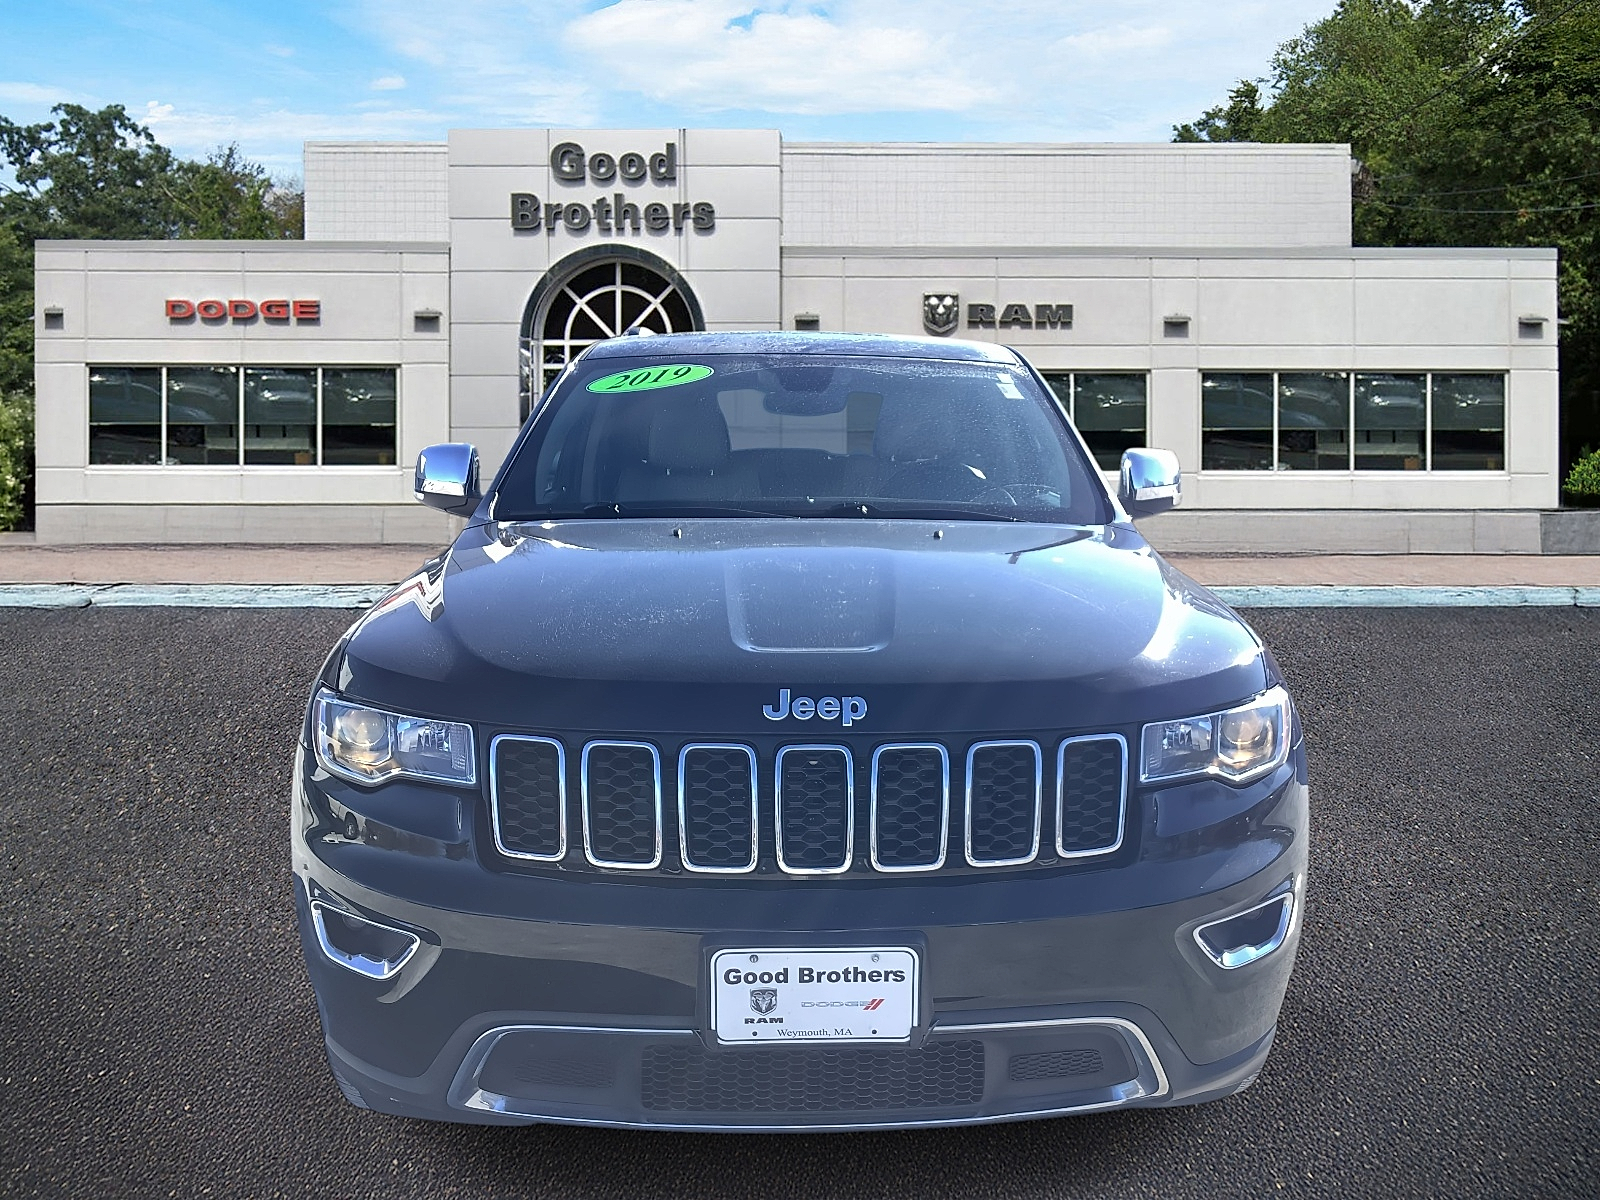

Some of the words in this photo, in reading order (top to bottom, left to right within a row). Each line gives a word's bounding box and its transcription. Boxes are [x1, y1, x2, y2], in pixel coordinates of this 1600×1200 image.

[550, 142, 677, 181] Good
[510, 192, 716, 230] Brothers
[165, 299, 321, 319] DODGE
[967, 303, 1074, 323] RAM
[606, 366, 692, 390] 2019
[762, 688, 868, 727] Jeep
[723, 967, 789, 985] Good
[798, 966, 906, 984] Brothers
[800, 1000, 872, 1008] DODGE
[744, 1017, 784, 1025] RAM
[776, 1028, 831, 1039] Weymouth,
[834, 1028, 853, 1036] MA
